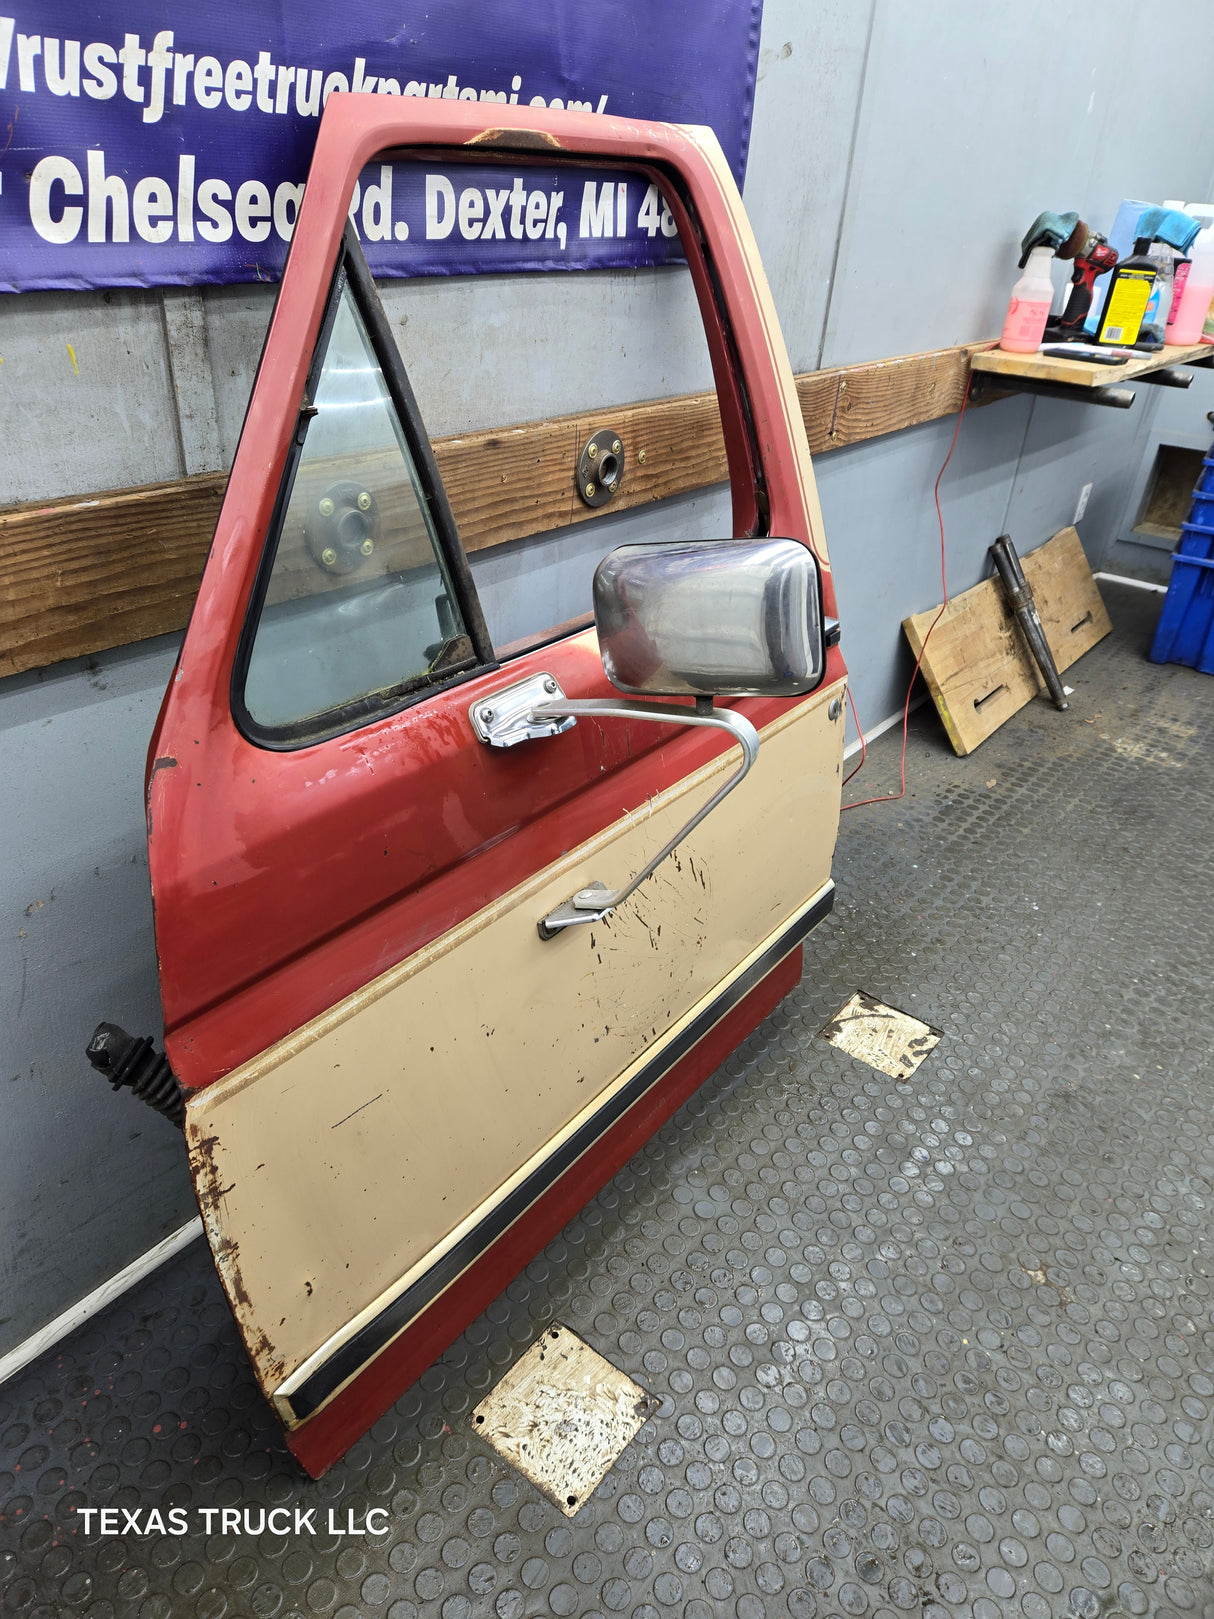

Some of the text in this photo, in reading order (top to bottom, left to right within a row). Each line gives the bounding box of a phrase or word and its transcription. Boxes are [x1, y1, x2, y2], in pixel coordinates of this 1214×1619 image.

[29, 150, 307, 244] Chelsea
[425, 174, 568, 250] Dexter,
[578, 181, 627, 240] MI
